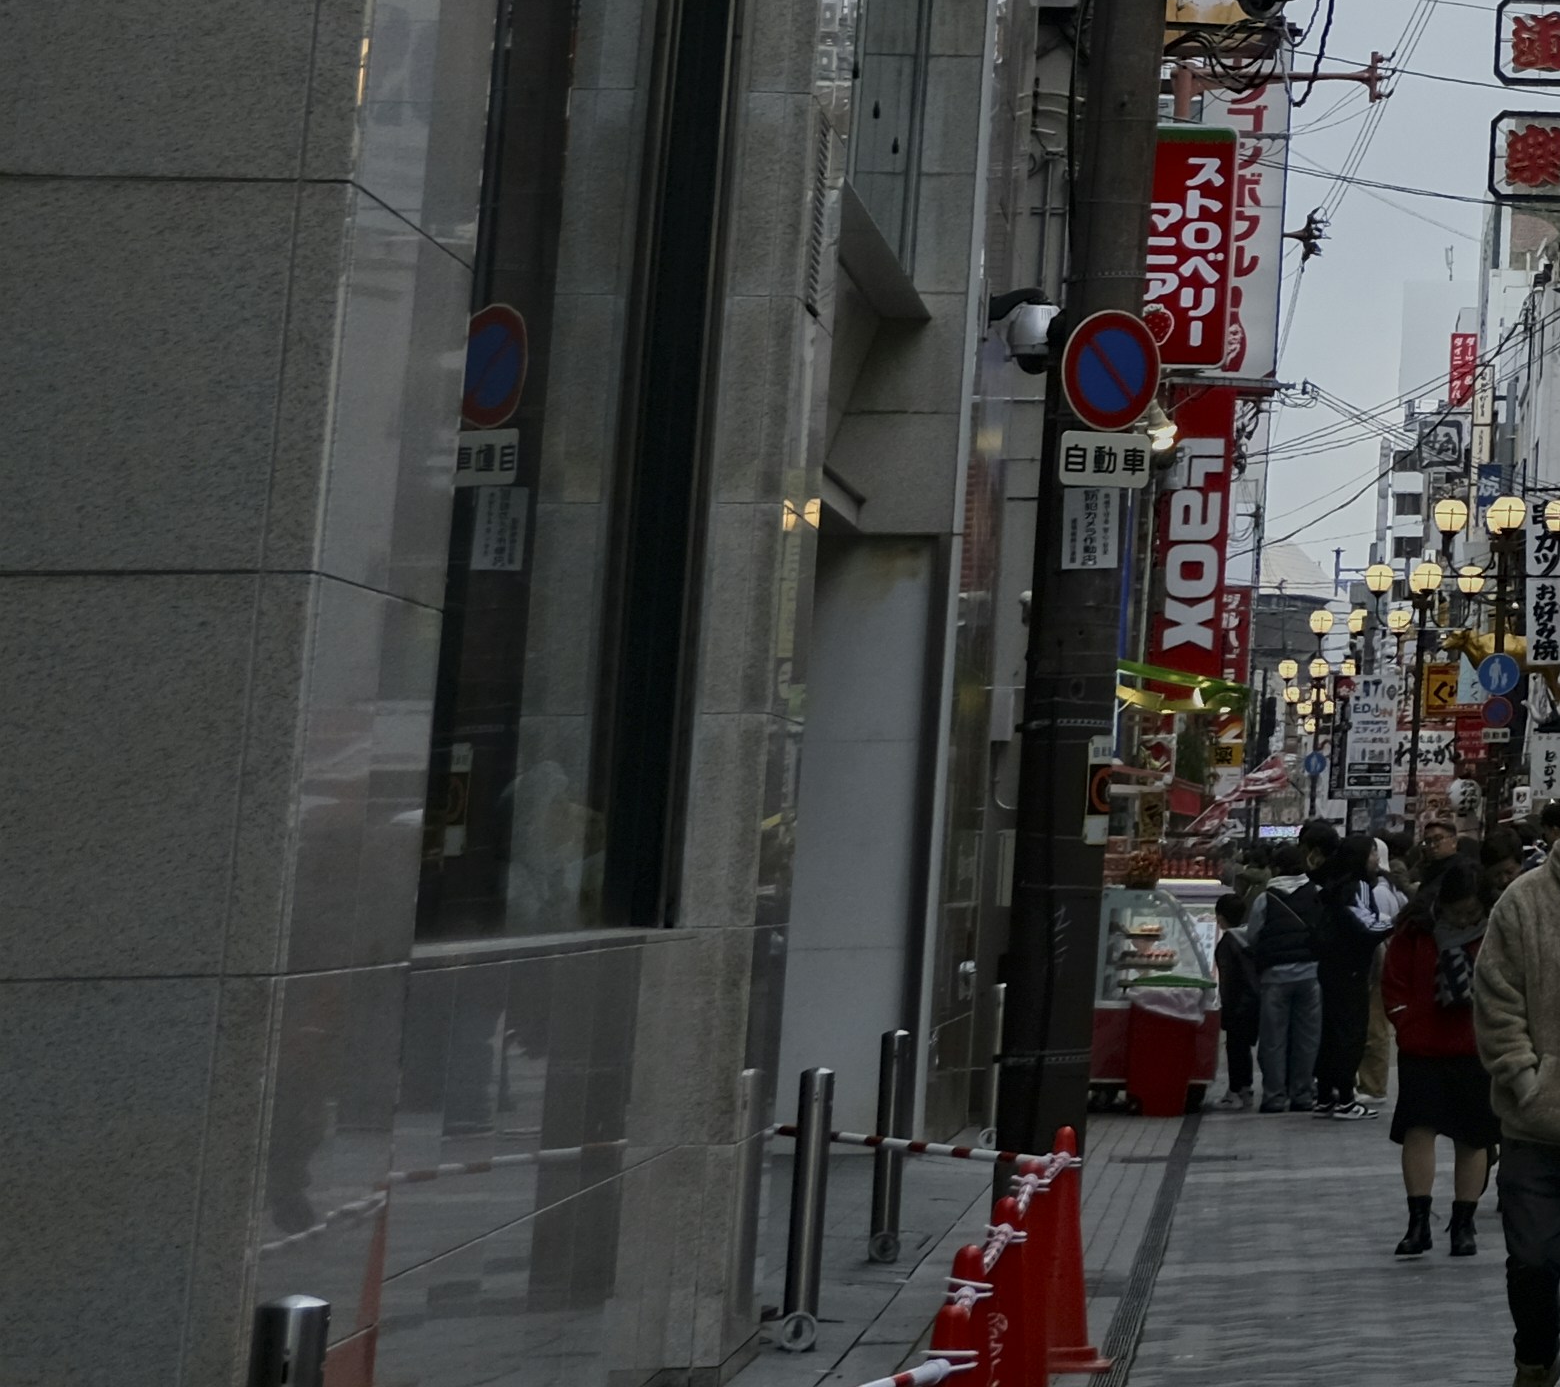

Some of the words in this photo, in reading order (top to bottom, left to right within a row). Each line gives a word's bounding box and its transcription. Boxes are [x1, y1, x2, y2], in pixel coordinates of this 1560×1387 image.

[1179, 157, 1225, 347] ストロベリー
[1064, 444, 1146, 475] 自動車
